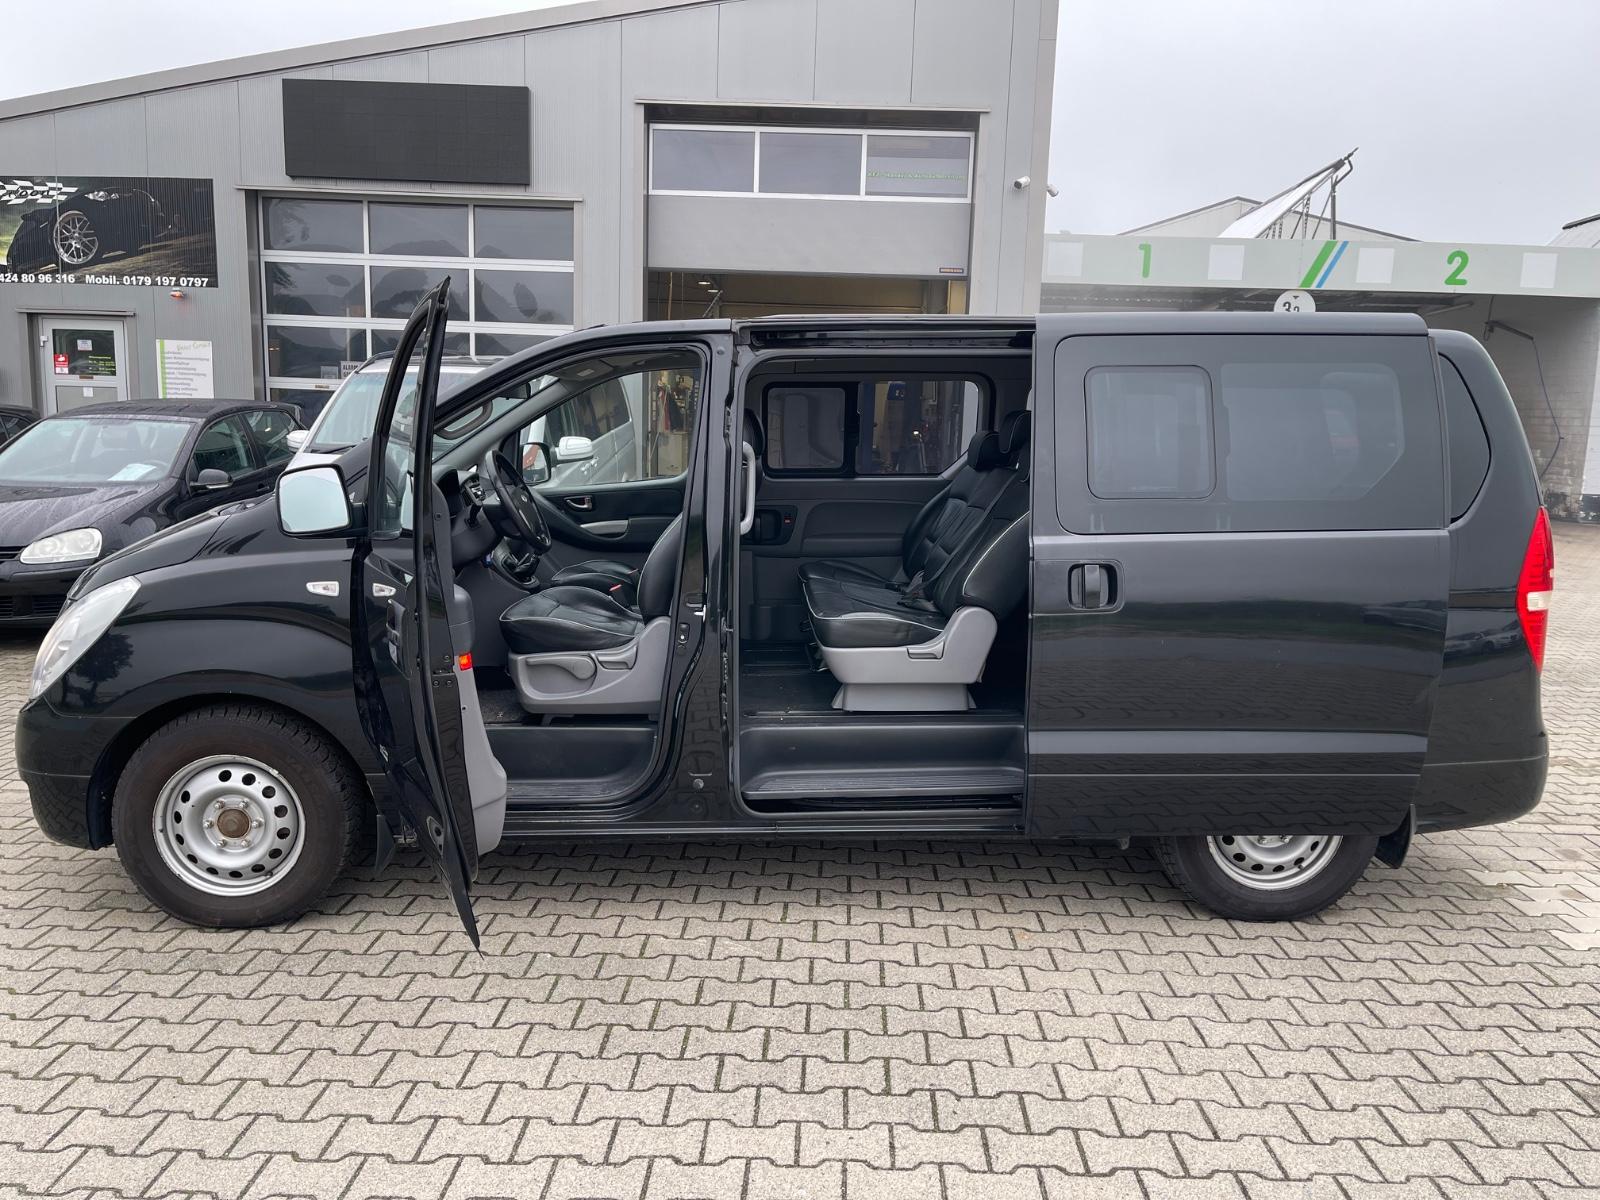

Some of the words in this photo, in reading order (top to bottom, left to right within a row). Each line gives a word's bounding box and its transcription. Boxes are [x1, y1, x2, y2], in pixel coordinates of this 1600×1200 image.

[1138, 243, 1152, 279] 1
[1444, 250, 1469, 286] 2
[21, 273, 36, 283] 80
[38, 273, 53, 284] 96
[55, 273, 76, 284] 316
[85, 274, 120, 285] Mobil.
[122, 275, 152, 286] 0179
[155, 276, 177, 286] 197
[179, 276, 209, 287] 0797
